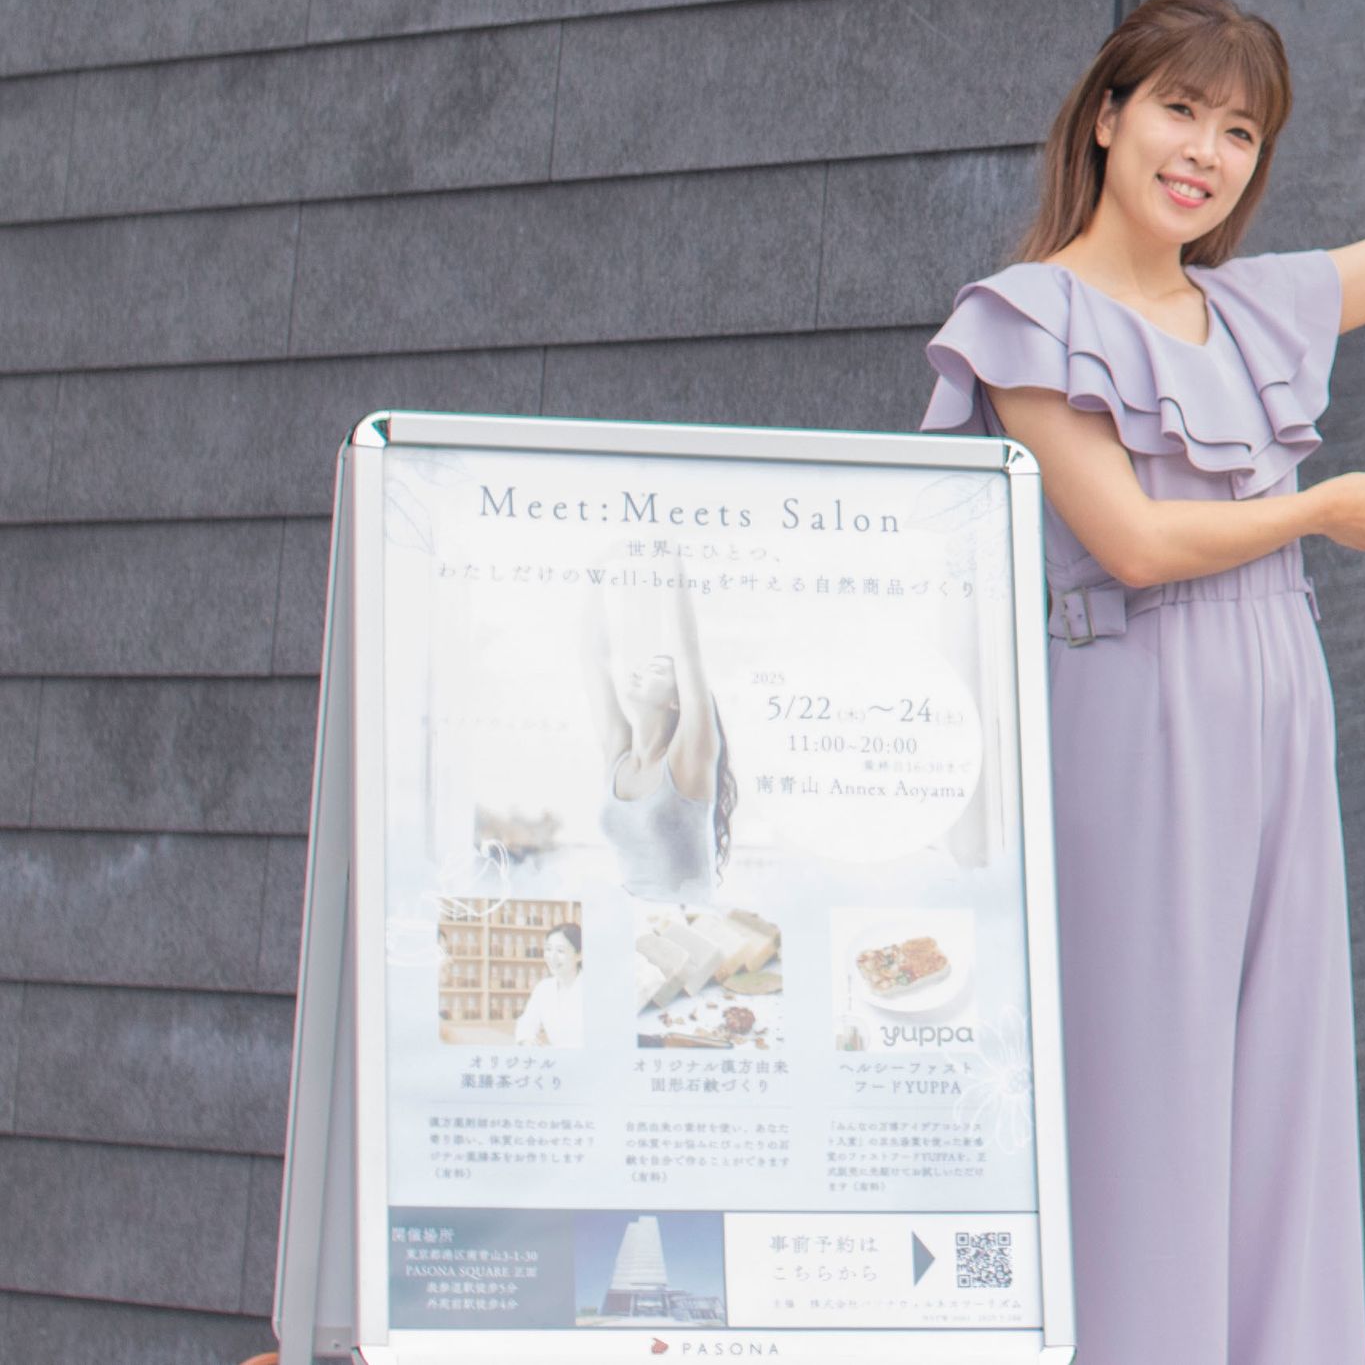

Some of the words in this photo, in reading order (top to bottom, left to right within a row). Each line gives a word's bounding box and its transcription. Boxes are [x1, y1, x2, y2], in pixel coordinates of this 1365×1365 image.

[480, 486, 753, 528] Meet:Meets
[781, 498, 901, 534] Salon
[751, 671, 785, 685] 2025
[755, 775, 819, 795] 南青山
[830, 778, 887, 797] Annex
[894, 780, 966, 803] Aoyama
[880, 1025, 975, 1047] yuppa
[470, 1055, 556, 1069] オリジナル
[633, 1058, 790, 1074] オリジナル漢方由来
[840, 1062, 972, 1075] ヘルシーファスト
[855, 1080, 963, 1095] フードYUPPA
[769, 1235, 880, 1254] 事前予約は
[405, 1265, 457, 1277] PASONA
[459, 1266, 511, 1280] SQUARE
[773, 1264, 878, 1282] こちらから
[682, 1341, 781, 1356] PASONA
